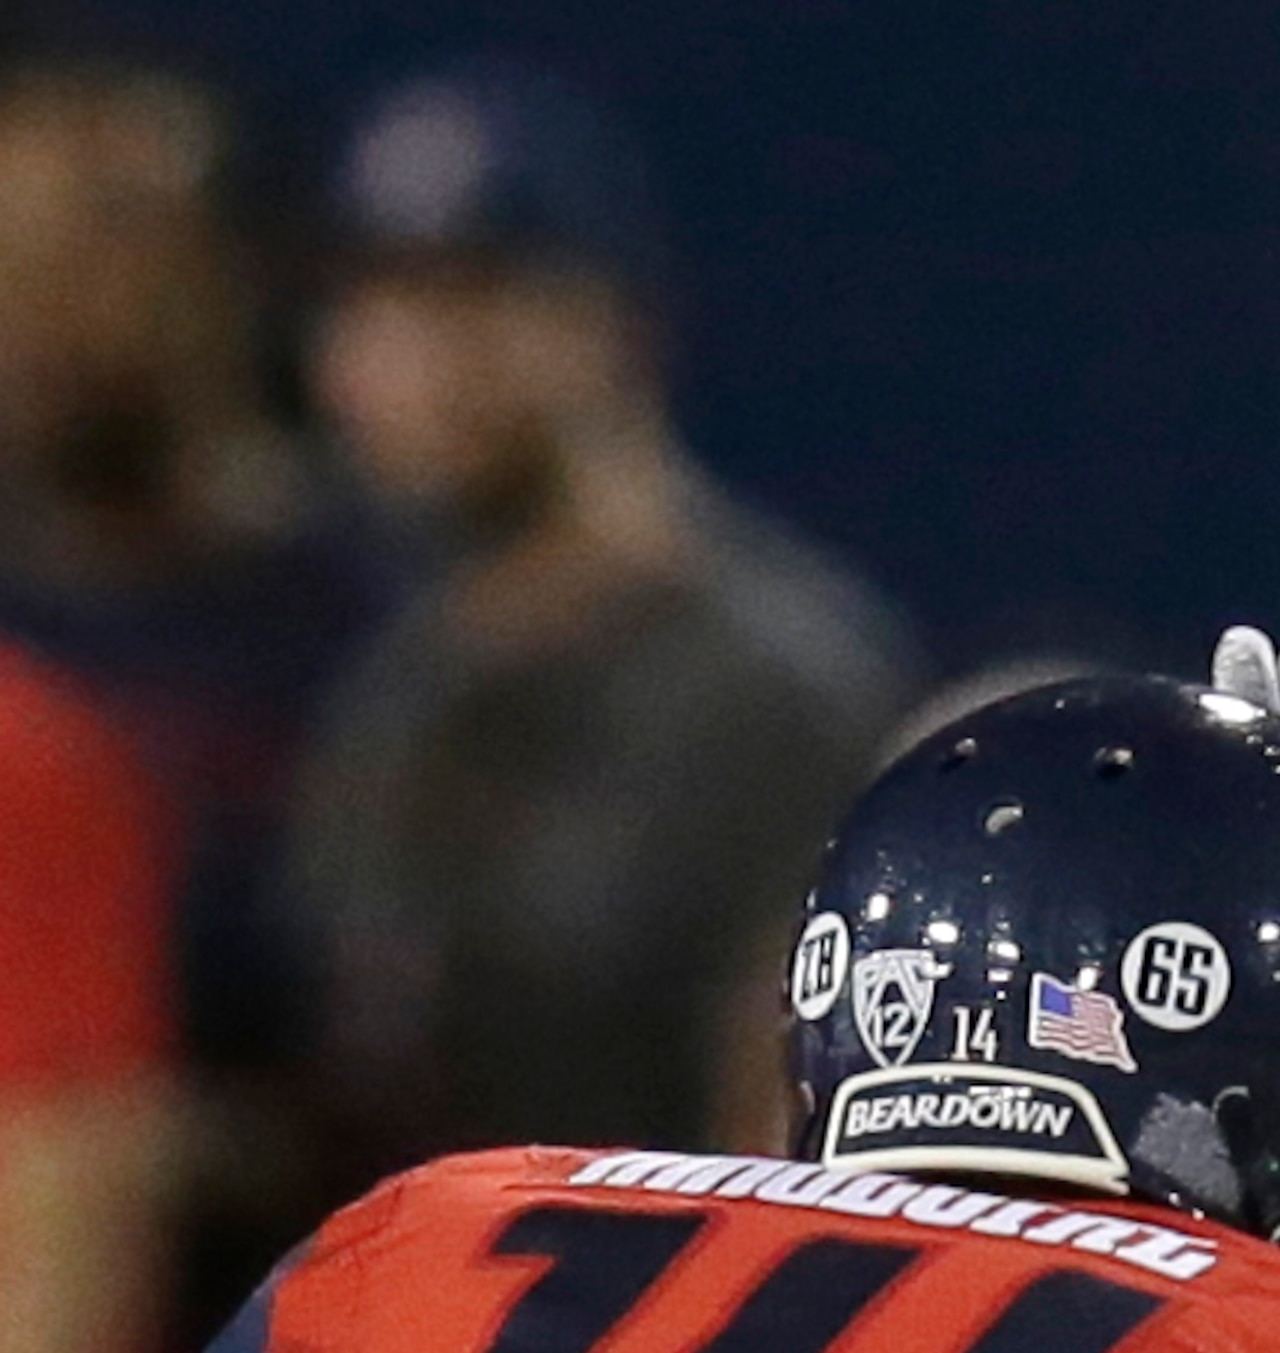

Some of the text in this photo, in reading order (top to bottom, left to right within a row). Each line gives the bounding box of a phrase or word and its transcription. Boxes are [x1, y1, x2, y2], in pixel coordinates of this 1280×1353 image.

[1137, 934, 1215, 1017] 65
[871, 1002, 911, 1048] 12
[951, 1005, 997, 1062] 14
[844, 1093, 1073, 1138] BEARDOWN
